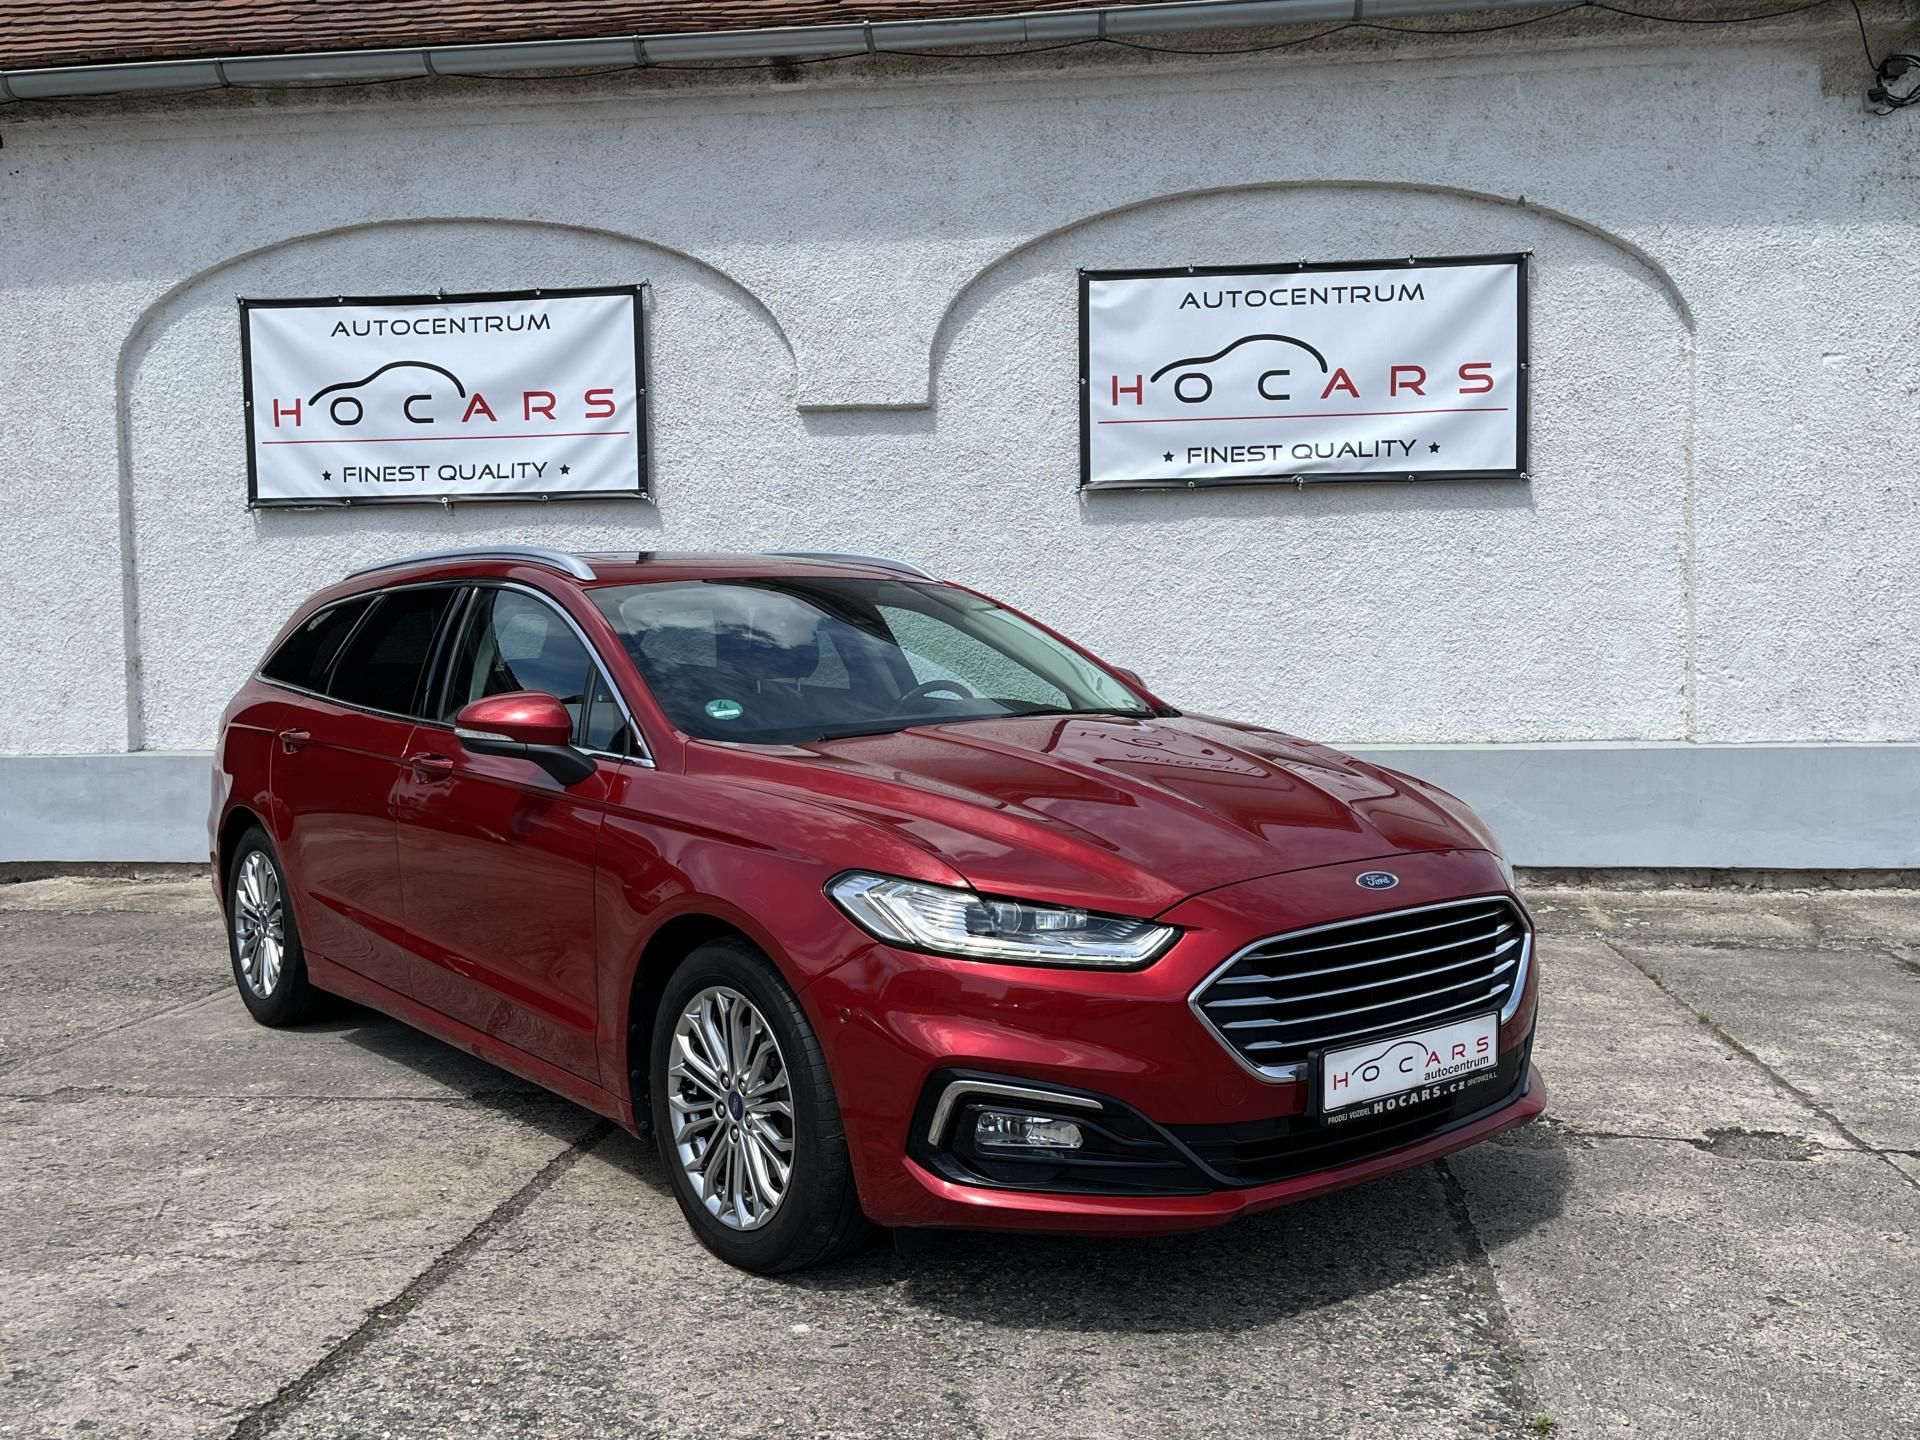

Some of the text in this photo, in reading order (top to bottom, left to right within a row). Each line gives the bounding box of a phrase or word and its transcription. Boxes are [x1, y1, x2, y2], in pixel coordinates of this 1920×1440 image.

[1179, 283, 1425, 310] AUTOCENTRUM
[331, 313, 551, 337] AUTOCENTRUM
[1187, 438, 1417, 464] FINEST QUALITY
[343, 461, 548, 483] FINEST QUALITY
[1365, 874, 1391, 886] Ford
[1424, 1055, 1489, 1081] autocentrum
[1328, 1113, 1348, 1125] PRODEJ
[1349, 1107, 1371, 1119] VOZIDEL
